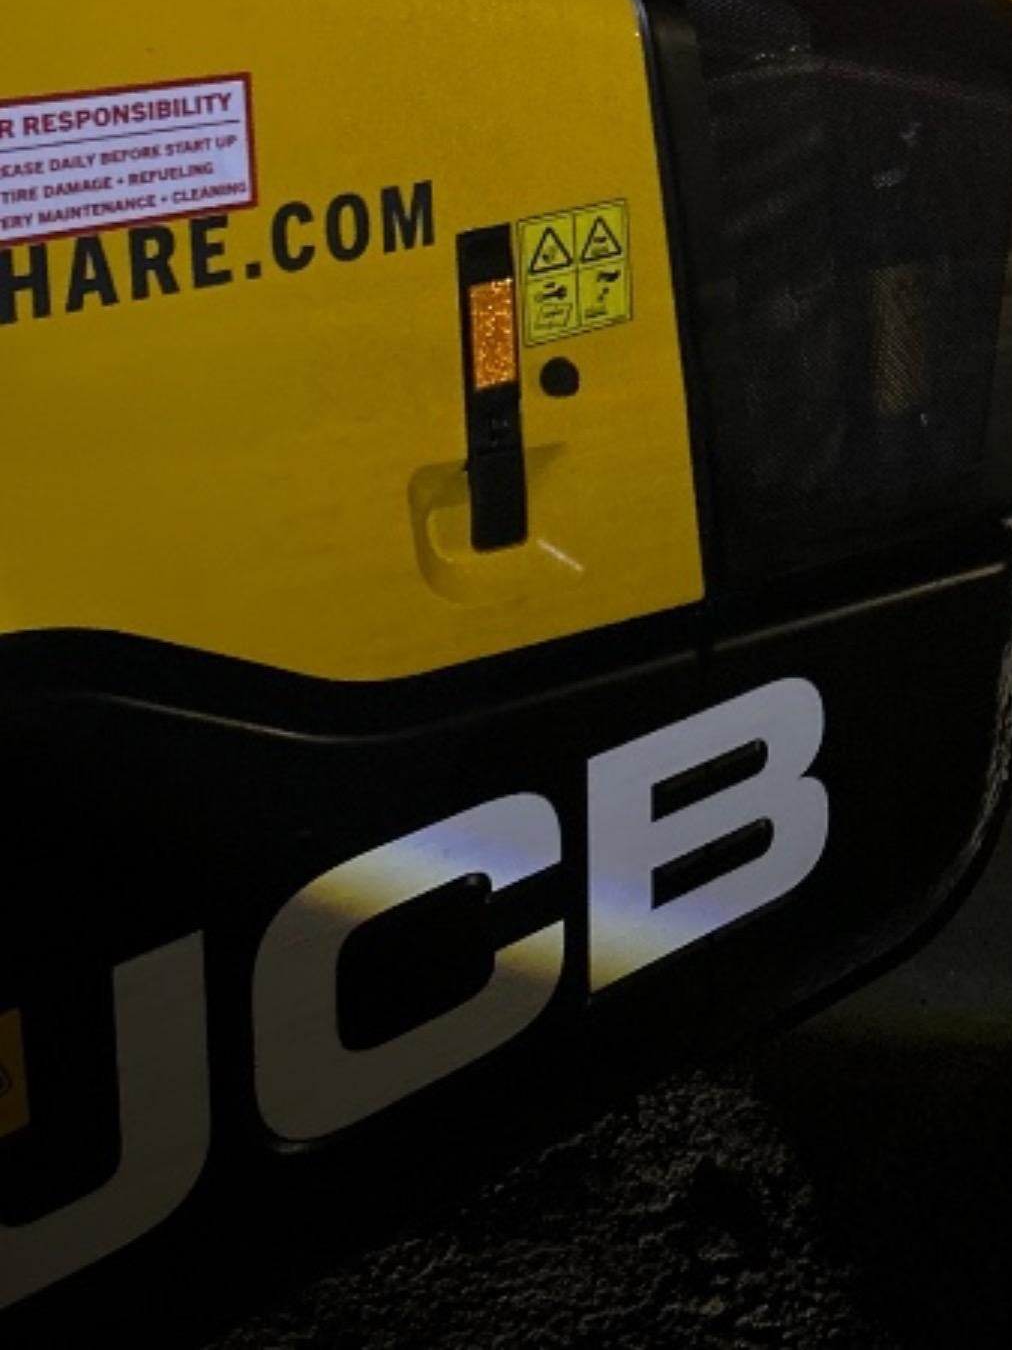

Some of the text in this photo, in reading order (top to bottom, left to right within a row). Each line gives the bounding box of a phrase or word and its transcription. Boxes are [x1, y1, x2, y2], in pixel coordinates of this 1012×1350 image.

[23, 93, 232, 136] RESPONSIBILITY
[50, 154, 96, 172] DAILY
[101, 145, 161, 166] BEFORE
[165, 138, 212, 157] START
[215, 135, 238, 149] UP
[1, 162, 214, 204] TIRE DAMAGE REFUELING
[38, 197, 157, 226] MAINTENANCE
[172, 182, 247, 205] CLEANING
[0, 179, 435, 325] HARE.COM
[0, 676, 830, 1310] JCB
